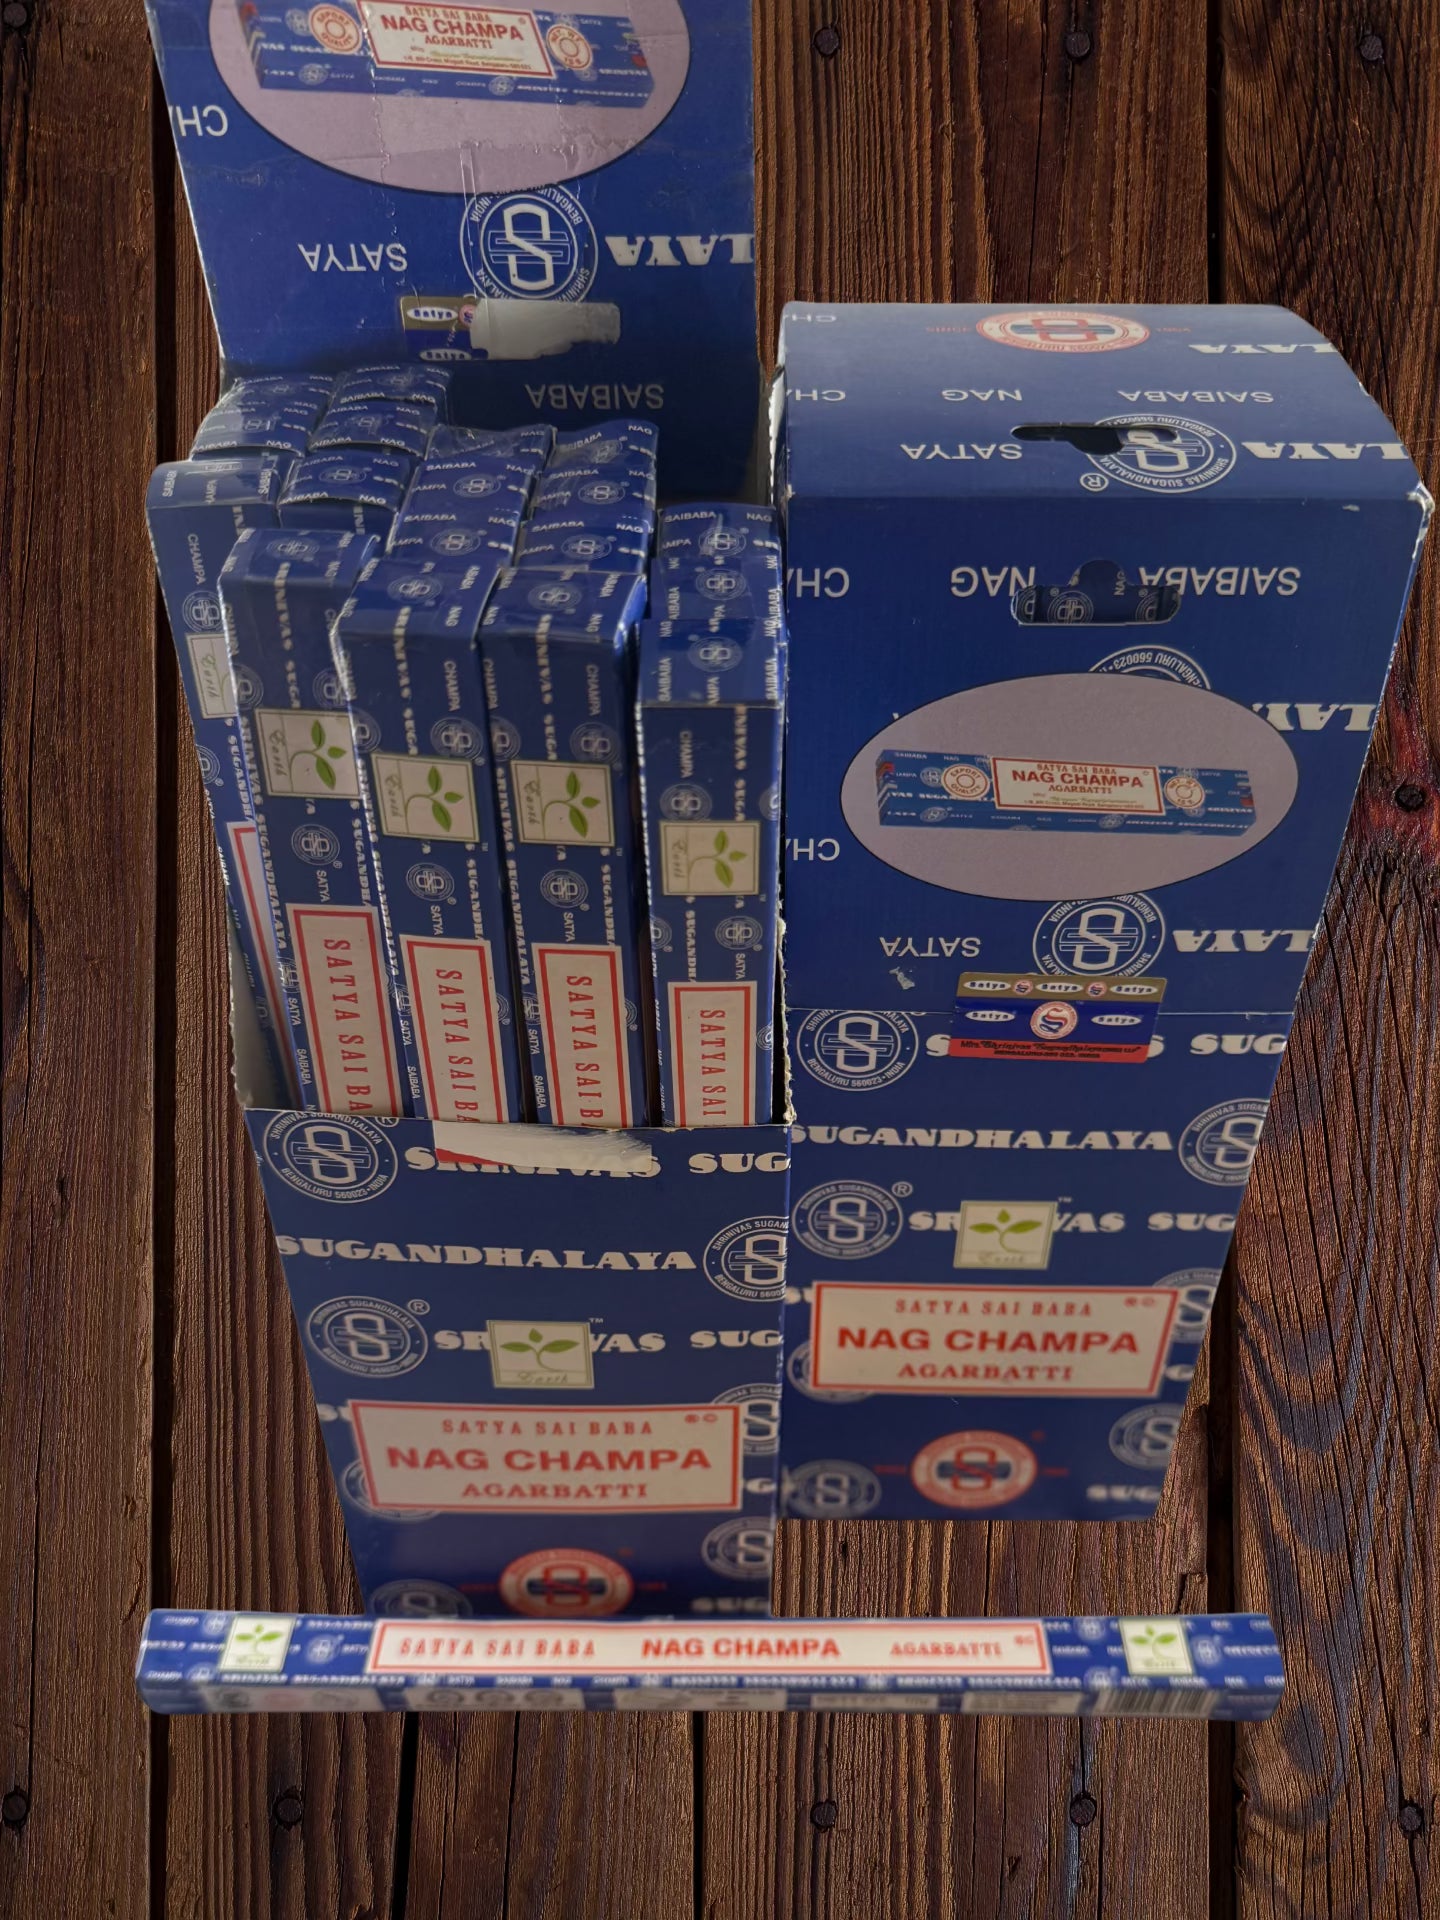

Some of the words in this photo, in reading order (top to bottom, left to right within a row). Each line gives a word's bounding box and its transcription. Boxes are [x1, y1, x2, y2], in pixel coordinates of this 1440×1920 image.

[381, 14, 428, 33] NAG
[433, 19, 524, 41] CHAMPA
[425, 34, 493, 49] AGARBATTI
[171, 104, 228, 138] CH
[298, 243, 408, 272] SATYA
[414, 309, 453, 321] Satya
[525, 384, 664, 409] SAIBABA
[942, 388, 1023, 402] NAG
[1117, 389, 1274, 404] SAIBABA
[628, 424, 653, 435] NAG
[900, 443, 1023, 461] SATYA
[664, 510, 717, 523] SAIBABA
[746, 512, 773, 523] NAG
[187, 533, 208, 586] CHAMPA
[787, 566, 850, 599] CH
[951, 565, 1037, 598] NAG
[1139, 566, 1301, 597] SAIBABA
[446, 604, 464, 628] NAG
[394, 606, 412, 699] SRINIVAS
[535, 613, 553, 705] SRINIVAS
[443, 660, 461, 712] CHAMPA
[585, 663, 602, 717] CHAMPA
[1012, 770, 1054, 783] NAG
[1060, 773, 1144, 788] CHAMPA
[1048, 785, 1112, 795] AGARBATTI
[316, 869, 331, 903] SATYA
[429, 904, 445, 937] SATYA
[505, 858, 531, 986] SUGANDHALAYA
[562, 911, 577, 943] SATYA
[880, 937, 981, 959] SATYA
[323, 938, 356, 1023] SATYA
[735, 952, 747, 980] SATYA
[970, 981, 1006, 990] Satya
[1042, 983, 1078, 992] Satya
[1116, 985, 1153, 994] Satya
[435, 968, 469, 1045] SATYA
[566, 974, 598, 1051] SATYA
[972, 1012, 1009, 1020] Satya
[1098, 1016, 1136, 1025] Satya
[288, 996, 303, 1027] SATYA
[296, 1047, 312, 1086] SAIBABA
[338, 1033, 369, 1074] SAI
[700, 1008, 727, 1077] SATYA
[399, 1019, 413, 1047] SATYA
[406, 1065, 422, 1101] SAIBABA
[448, 1055, 477, 1092] SAI
[527, 1028, 539, 1056] SATYA
[533, 1074, 547, 1110] SAIBABA
[807, 1058, 849, 1087] BENGALURU
[851, 1076, 882, 1088] 560023
[884, 1061, 906, 1080] INDIA
[574, 1062, 602, 1104] SAI
[702, 1086, 727, 1117] SAI
[792, 1124, 1173, 1151] SUGANDHALAYA
[280, 1167, 333, 1198] BENGALURU
[335, 1187, 369, 1200] 560023
[368, 1173, 389, 1191] INDIA
[711, 1222, 753, 1252] SHRINIVAS
[276, 1234, 698, 1272] SUGANDHALAYA
[895, 1298, 969, 1315] SATYA
[981, 1300, 1020, 1316] SAI
[1032, 1302, 1092, 1317] BABA
[837, 1325, 931, 1350] NAG
[944, 1328, 1140, 1354] CHAMPA
[898, 1362, 1074, 1381] AGARBATTI
[442, 1419, 522, 1436] SATYA
[535, 1421, 577, 1436] SAI
[589, 1420, 653, 1436] BABA
[386, 1446, 489, 1471] NAG
[503, 1448, 712, 1472] CHAMPA
[462, 1482, 648, 1499] AGARBATTI
[400, 1638, 475, 1657] SATYA
[486, 1639, 524, 1657] SAI
[534, 1639, 596, 1657] BABA
[640, 1637, 705, 1658] NAG
[712, 1637, 840, 1658] CHAMPA
[889, 1641, 1003, 1658] AGARBATTI
